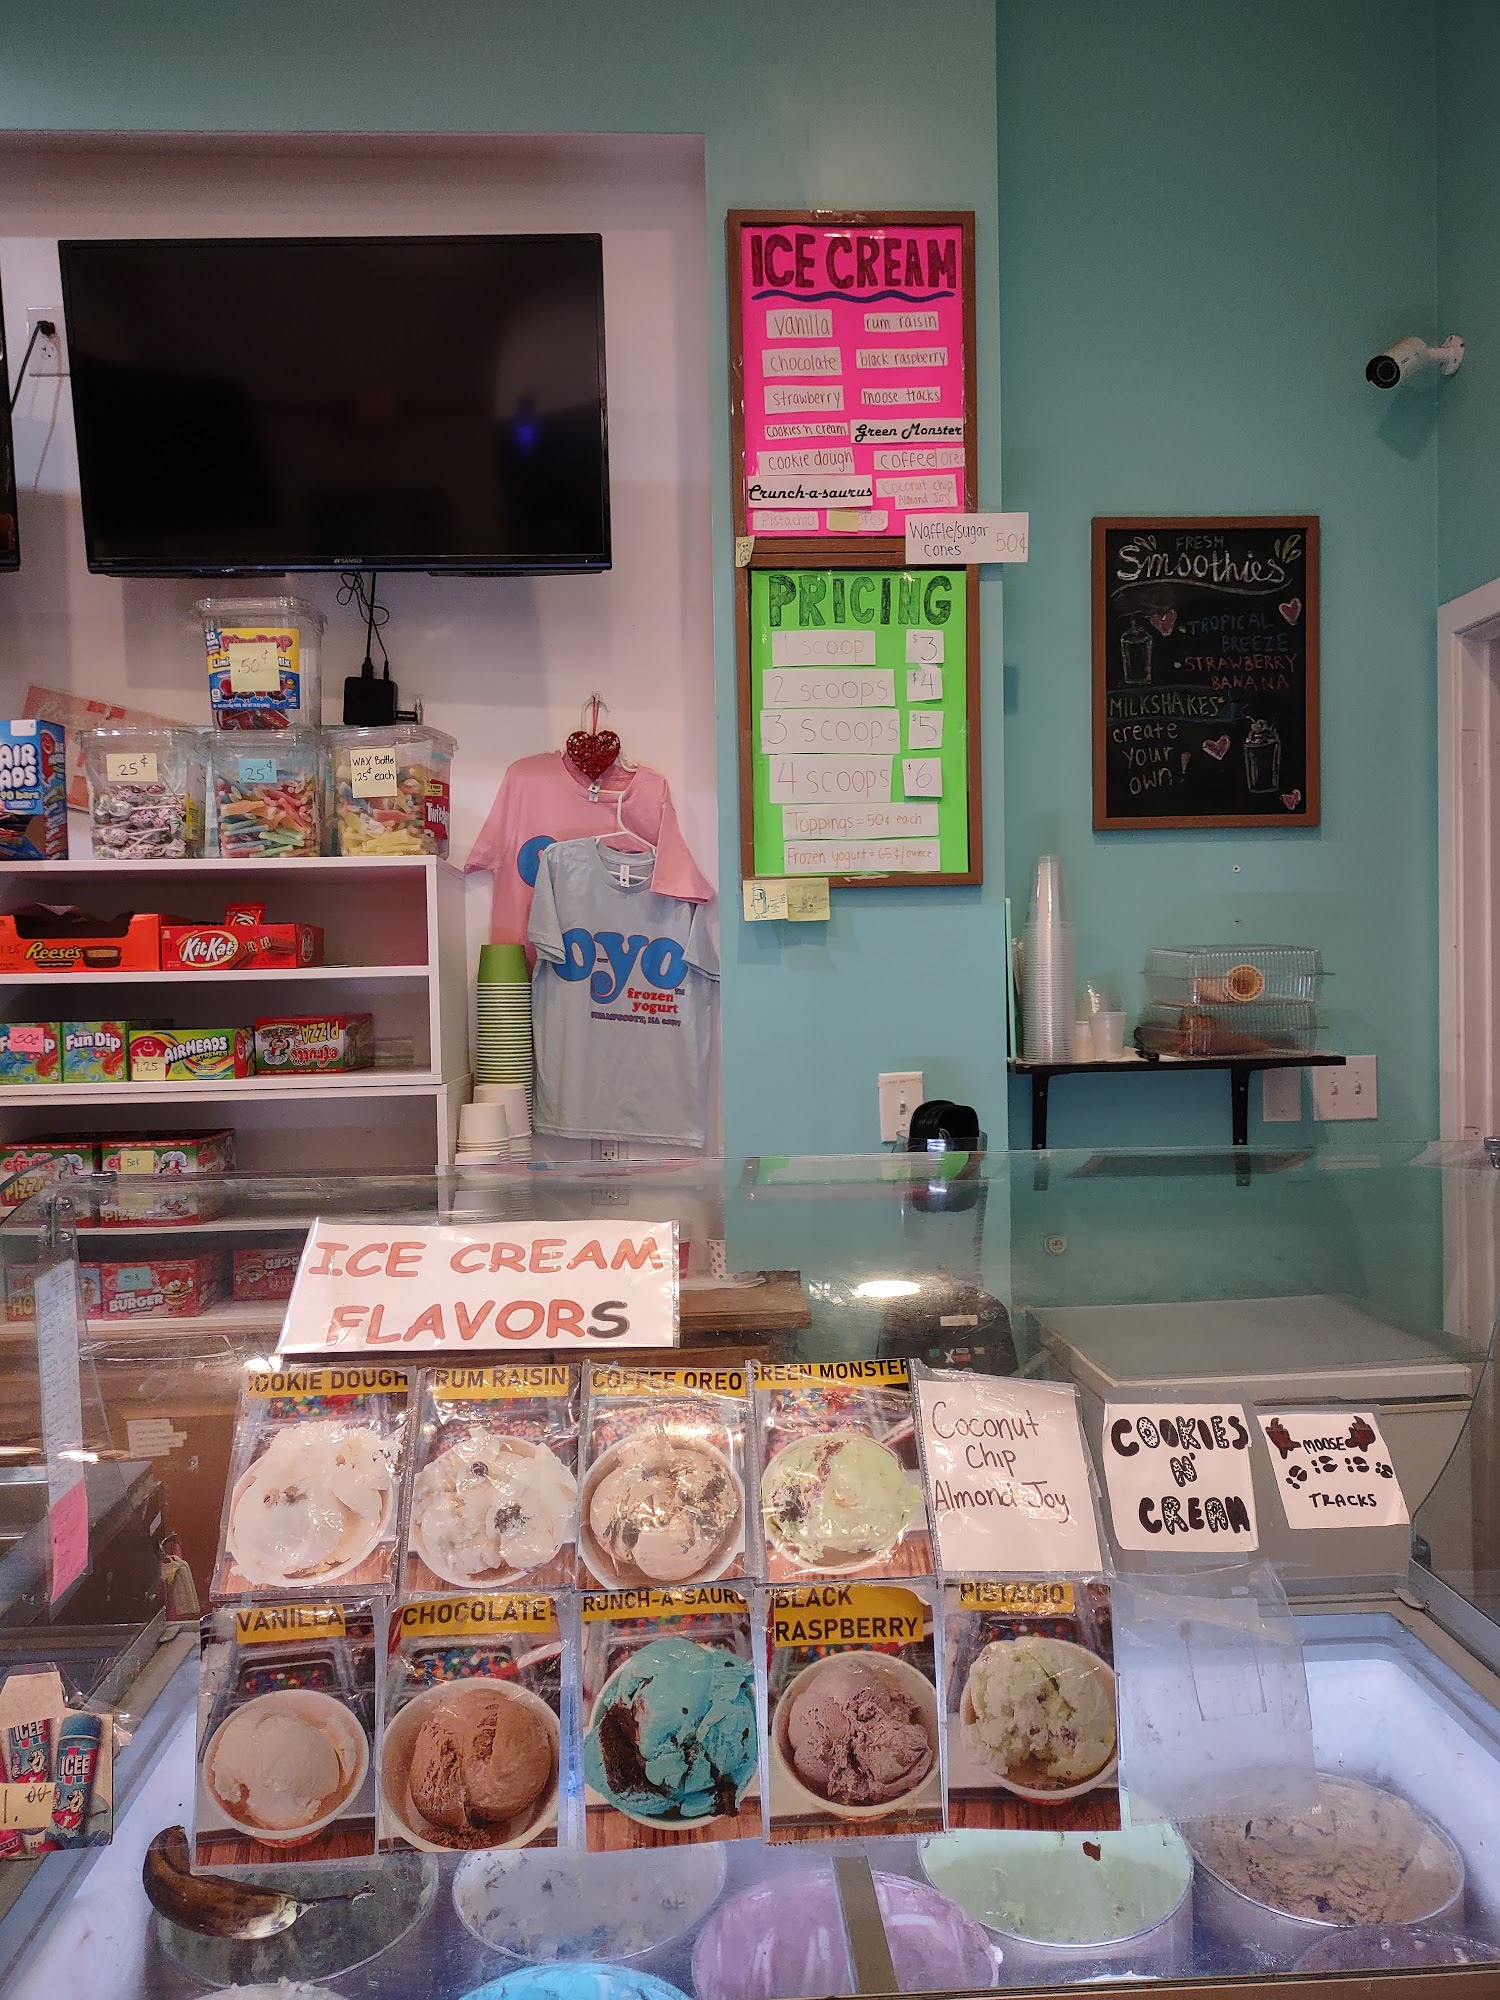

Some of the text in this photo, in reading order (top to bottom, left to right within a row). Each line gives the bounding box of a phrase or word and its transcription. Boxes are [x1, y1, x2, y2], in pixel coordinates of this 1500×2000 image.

[750, 234, 957, 288] ICE CREAM
[866, 314, 937, 330] rum raisin
[770, 355, 837, 372] chocolate
[860, 351, 946, 367] black raspberry
[773, 391, 840, 409] strawberry
[863, 388, 940, 404] moose tracks
[816, 424, 847, 435] cream
[854, 423, 962, 442] Green Monster
[768, 451, 853, 472] cookie dough
[748, 484, 872, 501] Crunch-a-saurus
[996, 532, 1027, 554] 50¢
[1175, 535, 1224, 551] FRESH
[1116, 544, 1287, 583] Smoothies
[768, 574, 953, 627] PRICING
[1187, 613, 1274, 635] TROPICAL
[801, 640, 864, 662] scoop
[1221, 632, 1289, 653] BREEZE
[1185, 653, 1297, 672] STRAWBERRY
[772, 675, 888, 706] 2 scoops
[1211, 674, 1290, 691] BANANA
[1109, 691, 1219, 718] MILKSHAKES
[764, 714, 899, 747] 3 scoops
[1112, 722, 1178, 743] create
[0, 743, 37, 768] AIR
[1121, 747, 1174, 768] your
[374, 770, 395, 781] each
[777, 762, 890, 798] 4 scoops
[786, 811, 853, 837] Toppings
[896, 813, 922, 825] each
[787, 847, 827, 866] Frozen
[832, 849, 867, 869] yogurt
[627, 987, 674, 1002] frozen
[632, 1001, 678, 1014] yogurt
[65, 1034, 94, 1051] Fun
[95, 1033, 121, 1053] Dip
[300, 1020, 340, 1045] PIZZA
[164, 1036, 228, 1065] AIRHEADS
[308, 1236, 665, 1278] ICE CREAM
[109, 1294, 165, 1313] BURGER
[326, 1299, 631, 1347] FLAVORS
[436, 1367, 567, 1388] RUM RAISIN
[592, 1368, 742, 1391] COFFEE OREO
[932, 1401, 1040, 1440] Coconut
[1111, 1415, 1250, 1457] COOKIES
[1302, 1437, 1346, 1454] MOOSE
[965, 1442, 1017, 1477] Chip
[935, 1480, 1071, 1524] Almond Joy
[1308, 1493, 1378, 1508] TRACKS
[1138, 1496, 1251, 1535] CREAM
[774, 1585, 852, 1609] BLACK
[236, 1604, 345, 1633] VANILLA
[402, 1599, 547, 1626] CHOCOLATE
[774, 1616, 919, 1642] RASPBERRY
[14, 1720, 44, 1743] ICEE
[59, 1756, 92, 1776] ICEE
